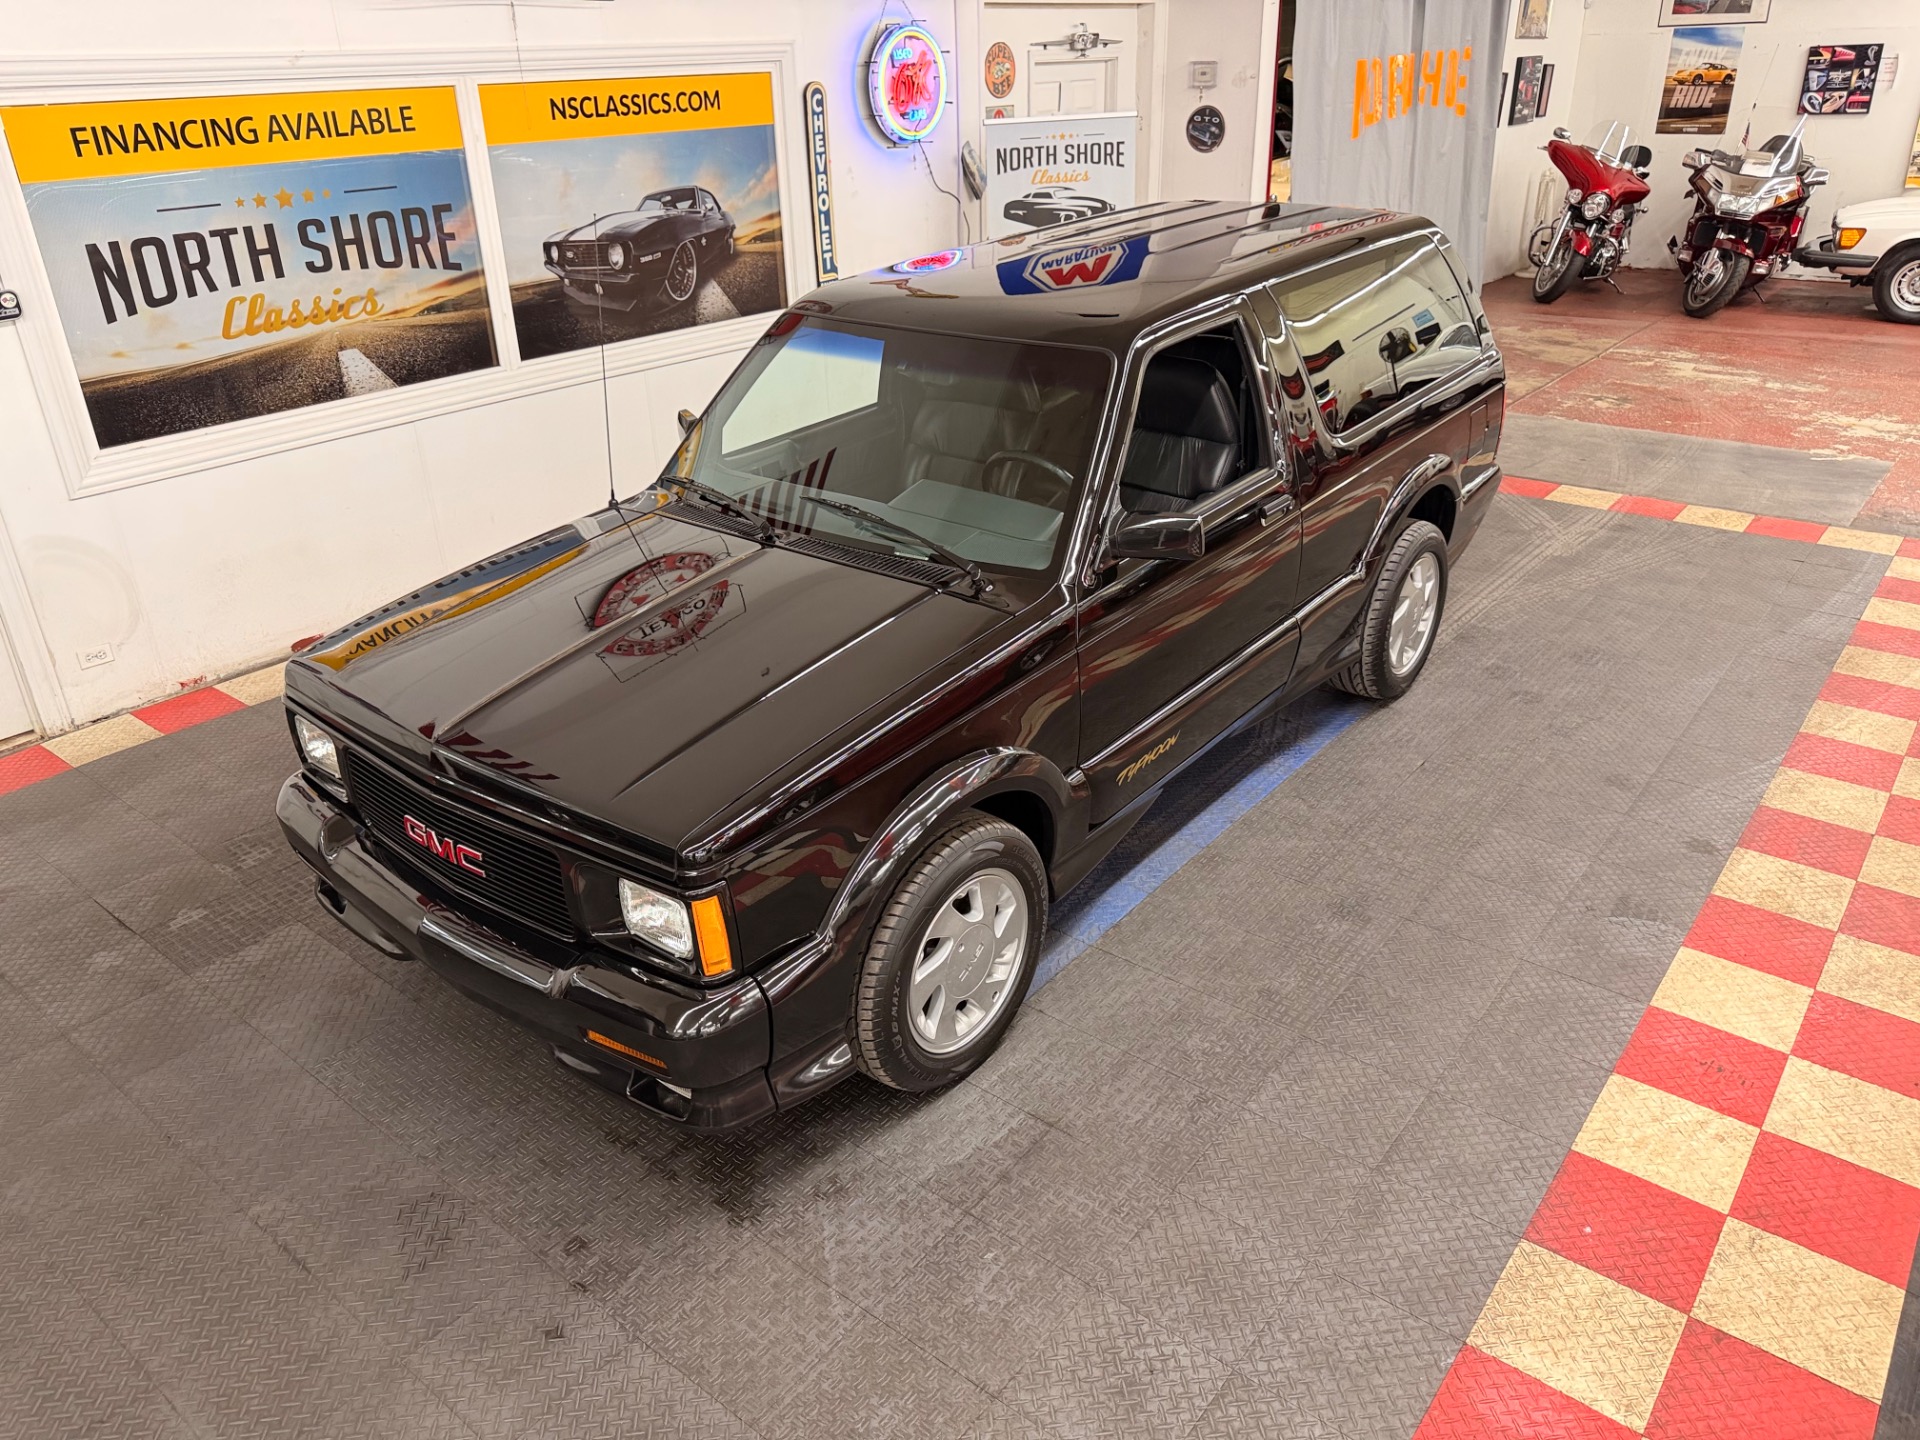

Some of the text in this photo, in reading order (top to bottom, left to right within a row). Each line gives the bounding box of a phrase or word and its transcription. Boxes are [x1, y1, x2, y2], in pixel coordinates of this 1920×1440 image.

[892, 47, 913, 60] USED
[992, 74, 1011, 95] BEE
[1669, 85, 1719, 108] RIDE
[549, 90, 721, 121] NSCLASSICS.COM
[1193, 115, 1220, 124] GTO
[69, 105, 416, 158] FINANCING AVAILABLE
[996, 141, 1125, 175] NORTH SHORE
[811, 93, 833, 270] CHEVROLET
[1031, 168, 1091, 185] Classics
[84, 203, 463, 325] NORTH SHORE
[221, 286, 385, 341] Classics
[1115, 730, 1181, 787] TYPHOON
[403, 814, 487, 878] GMC
